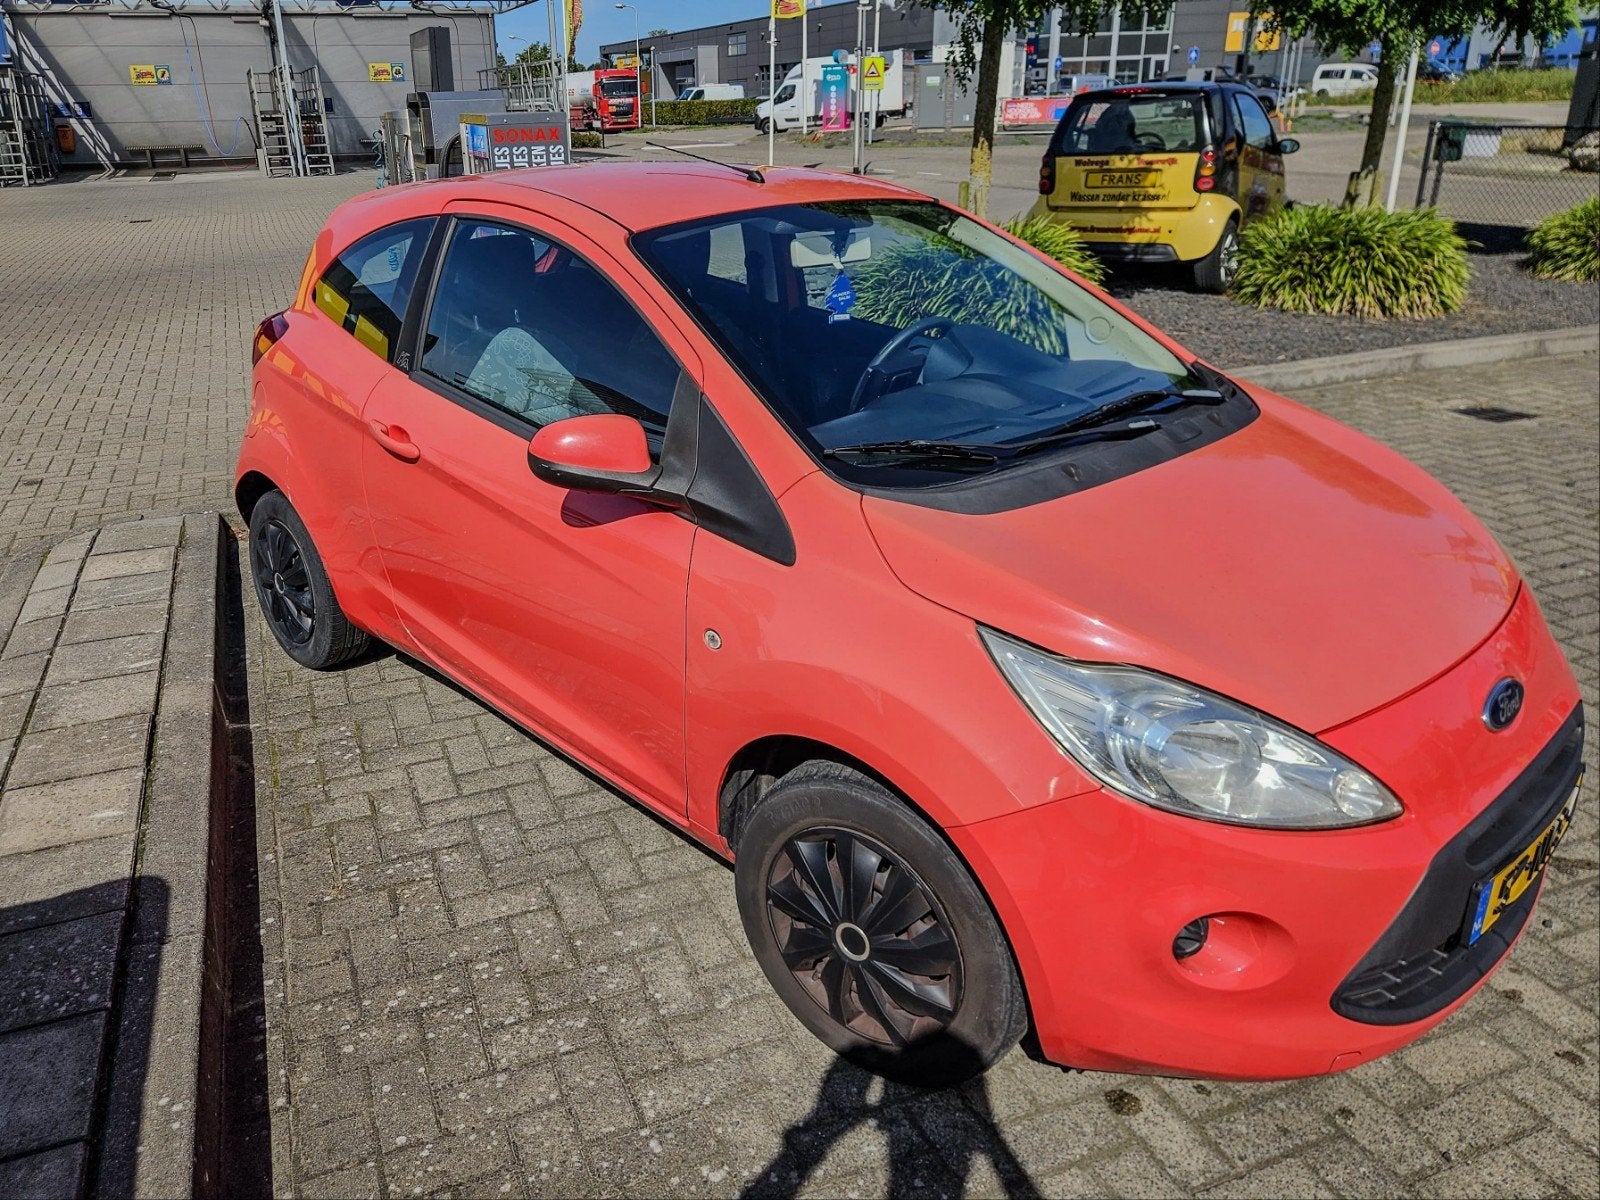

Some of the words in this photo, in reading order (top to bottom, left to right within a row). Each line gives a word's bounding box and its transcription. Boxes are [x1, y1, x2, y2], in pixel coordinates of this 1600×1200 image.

[493, 127, 560, 143] SONAX
[1101, 174, 1141, 185] FRANS
[1070, 191, 1100, 202] Wassen
[1102, 190, 1129, 202] zonder
[1498, 688, 1520, 722] Ford
